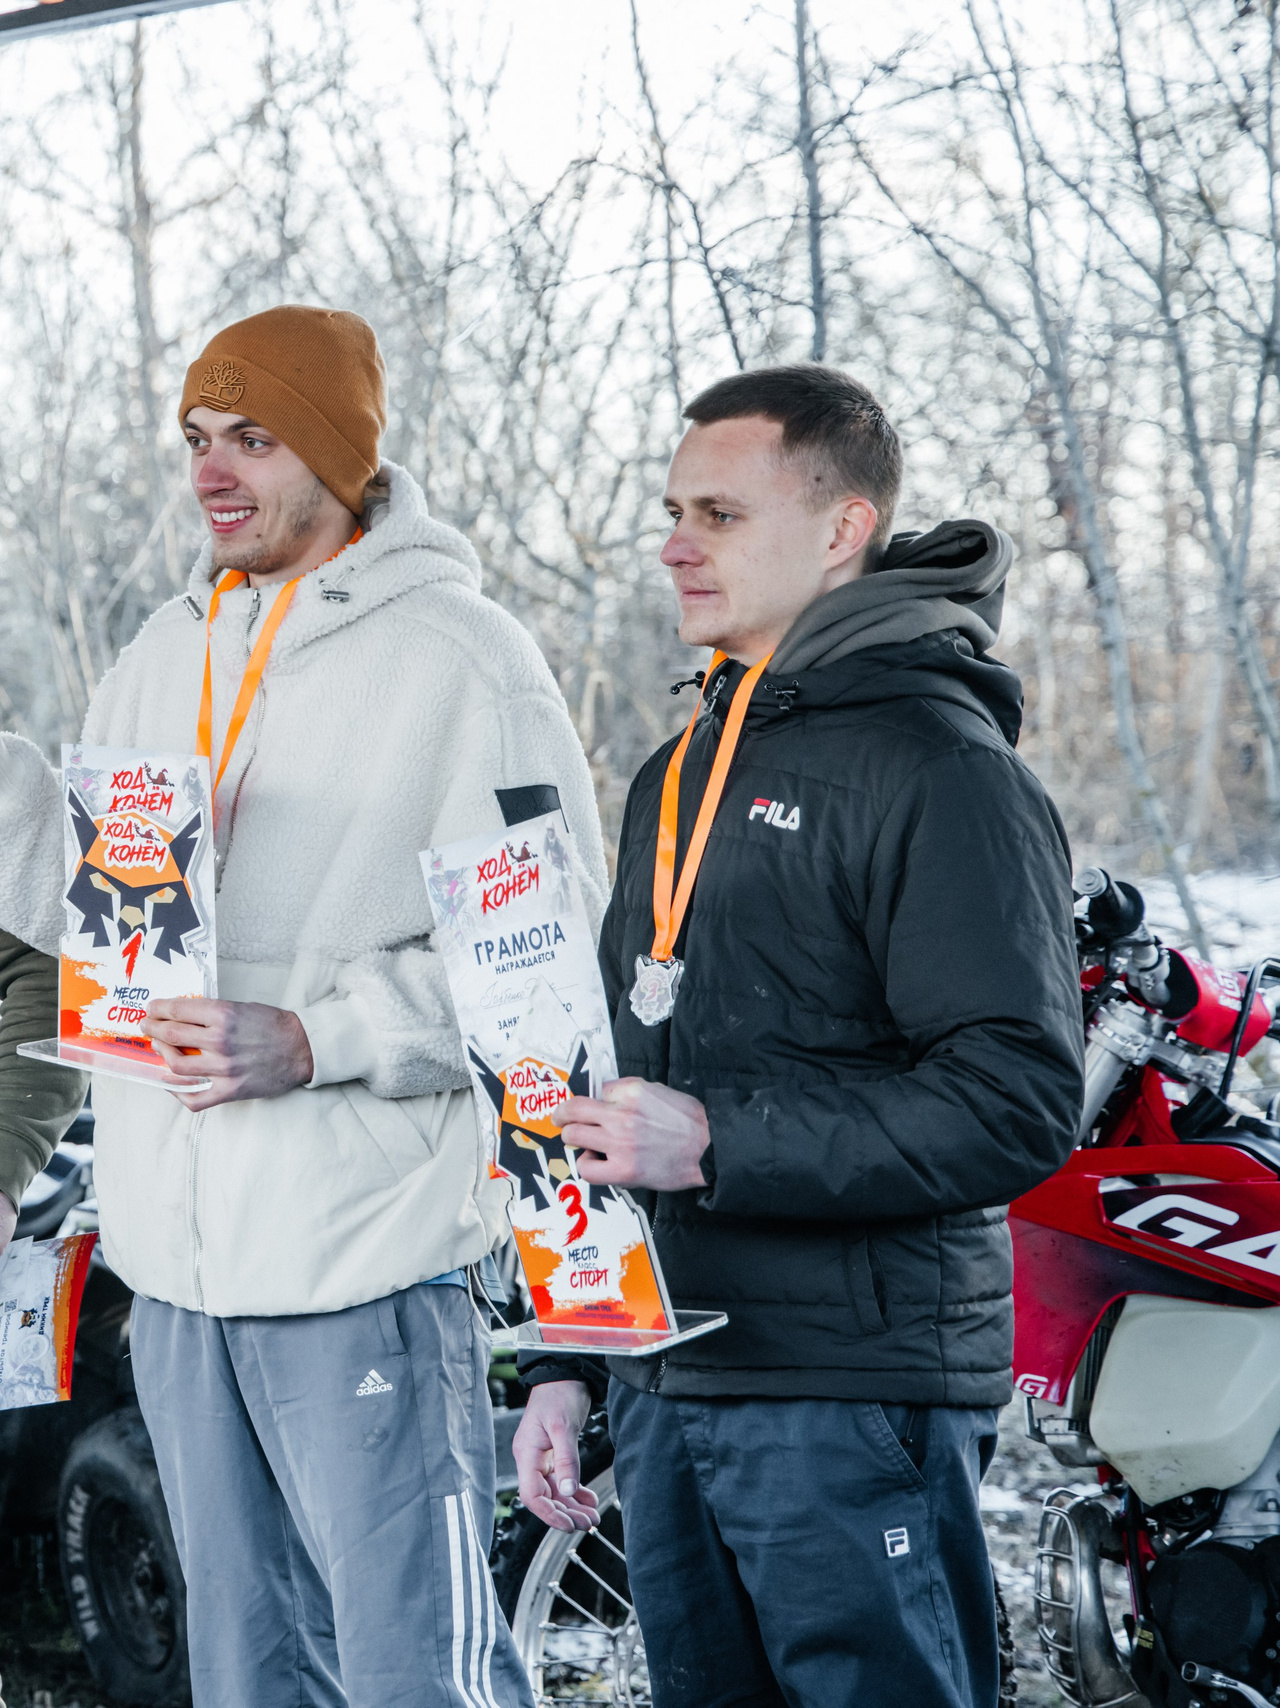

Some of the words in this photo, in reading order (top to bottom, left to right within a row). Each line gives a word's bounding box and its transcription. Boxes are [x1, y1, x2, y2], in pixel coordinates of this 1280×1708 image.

[109, 766, 146, 793] ХОД
[749, 798, 800, 831] FILA
[104, 820, 135, 842] ХОД
[108, 840, 166, 866] КОНЁМ
[476, 849, 512, 884] ХОД
[480, 863, 540, 915] КОНЁМ
[473, 920, 566, 966] ГРАМОТА
[121, 931, 143, 985] 1
[495, 950, 556, 975] НАГРАЖДАЕТСЯ
[113, 985, 149, 1000] МЕСТО
[107, 1006, 147, 1025] СПОР
[498, 1016, 519, 1030] ЗАНЯ
[509, 1066, 536, 1090] ХОД
[520, 1083, 567, 1114] КОНЁМ
[558, 1183, 588, 1247] 3
[568, 1246, 598, 1264] МЕСТО
[570, 1268, 609, 1289] СПОРТ
[2, 1313, 11, 1345] трениров
[356, 1383, 393, 1396] adidas
